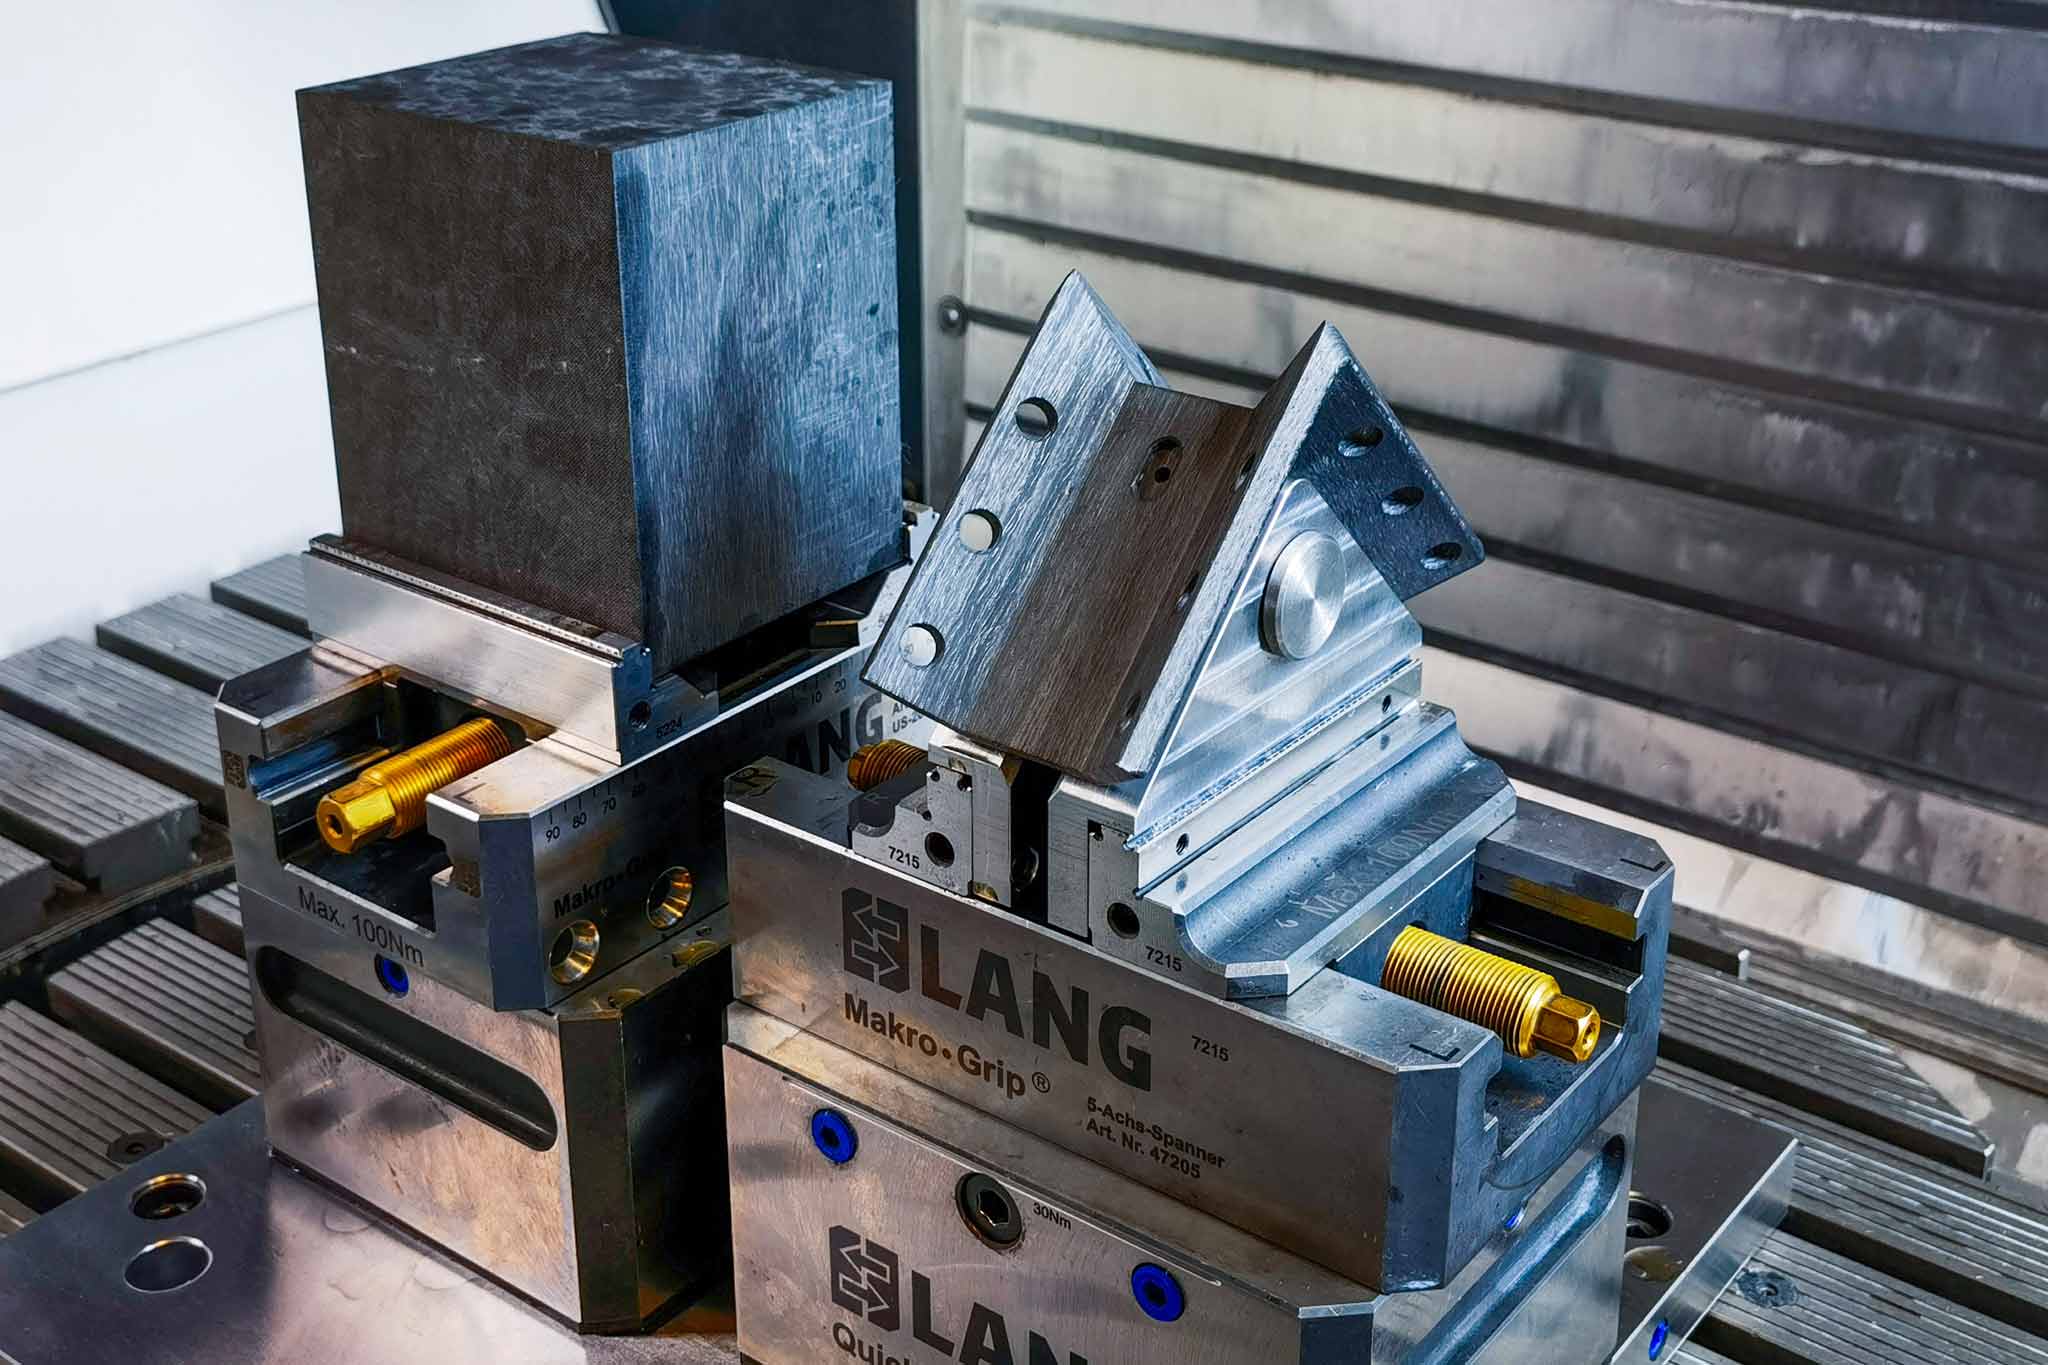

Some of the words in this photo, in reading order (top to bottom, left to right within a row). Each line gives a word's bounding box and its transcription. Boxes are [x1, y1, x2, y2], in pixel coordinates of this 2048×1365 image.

[811, 690, 823, 705] 10
[834, 678, 847, 693] 20
[602, 797, 617, 815] 70
[572, 811, 587, 829] 80
[545, 826, 561, 842] 90
[888, 845, 920, 870] 7215
[298, 885, 344, 929] Max.
[352, 914, 424, 968] 100Nm
[1145, 945, 1183, 972] 7215
[920, 924, 1152, 1092] LANG
[1191, 1035, 1230, 1063] 7215
[1087, 1095, 1226, 1169] 5-Achs-Spanner
[1086, 1117, 1117, 1143] Art.
[1121, 1131, 1145, 1155] Nr.
[1149, 1146, 1201, 1178] 47205
[1033, 1202, 1072, 1231] 30Nm
